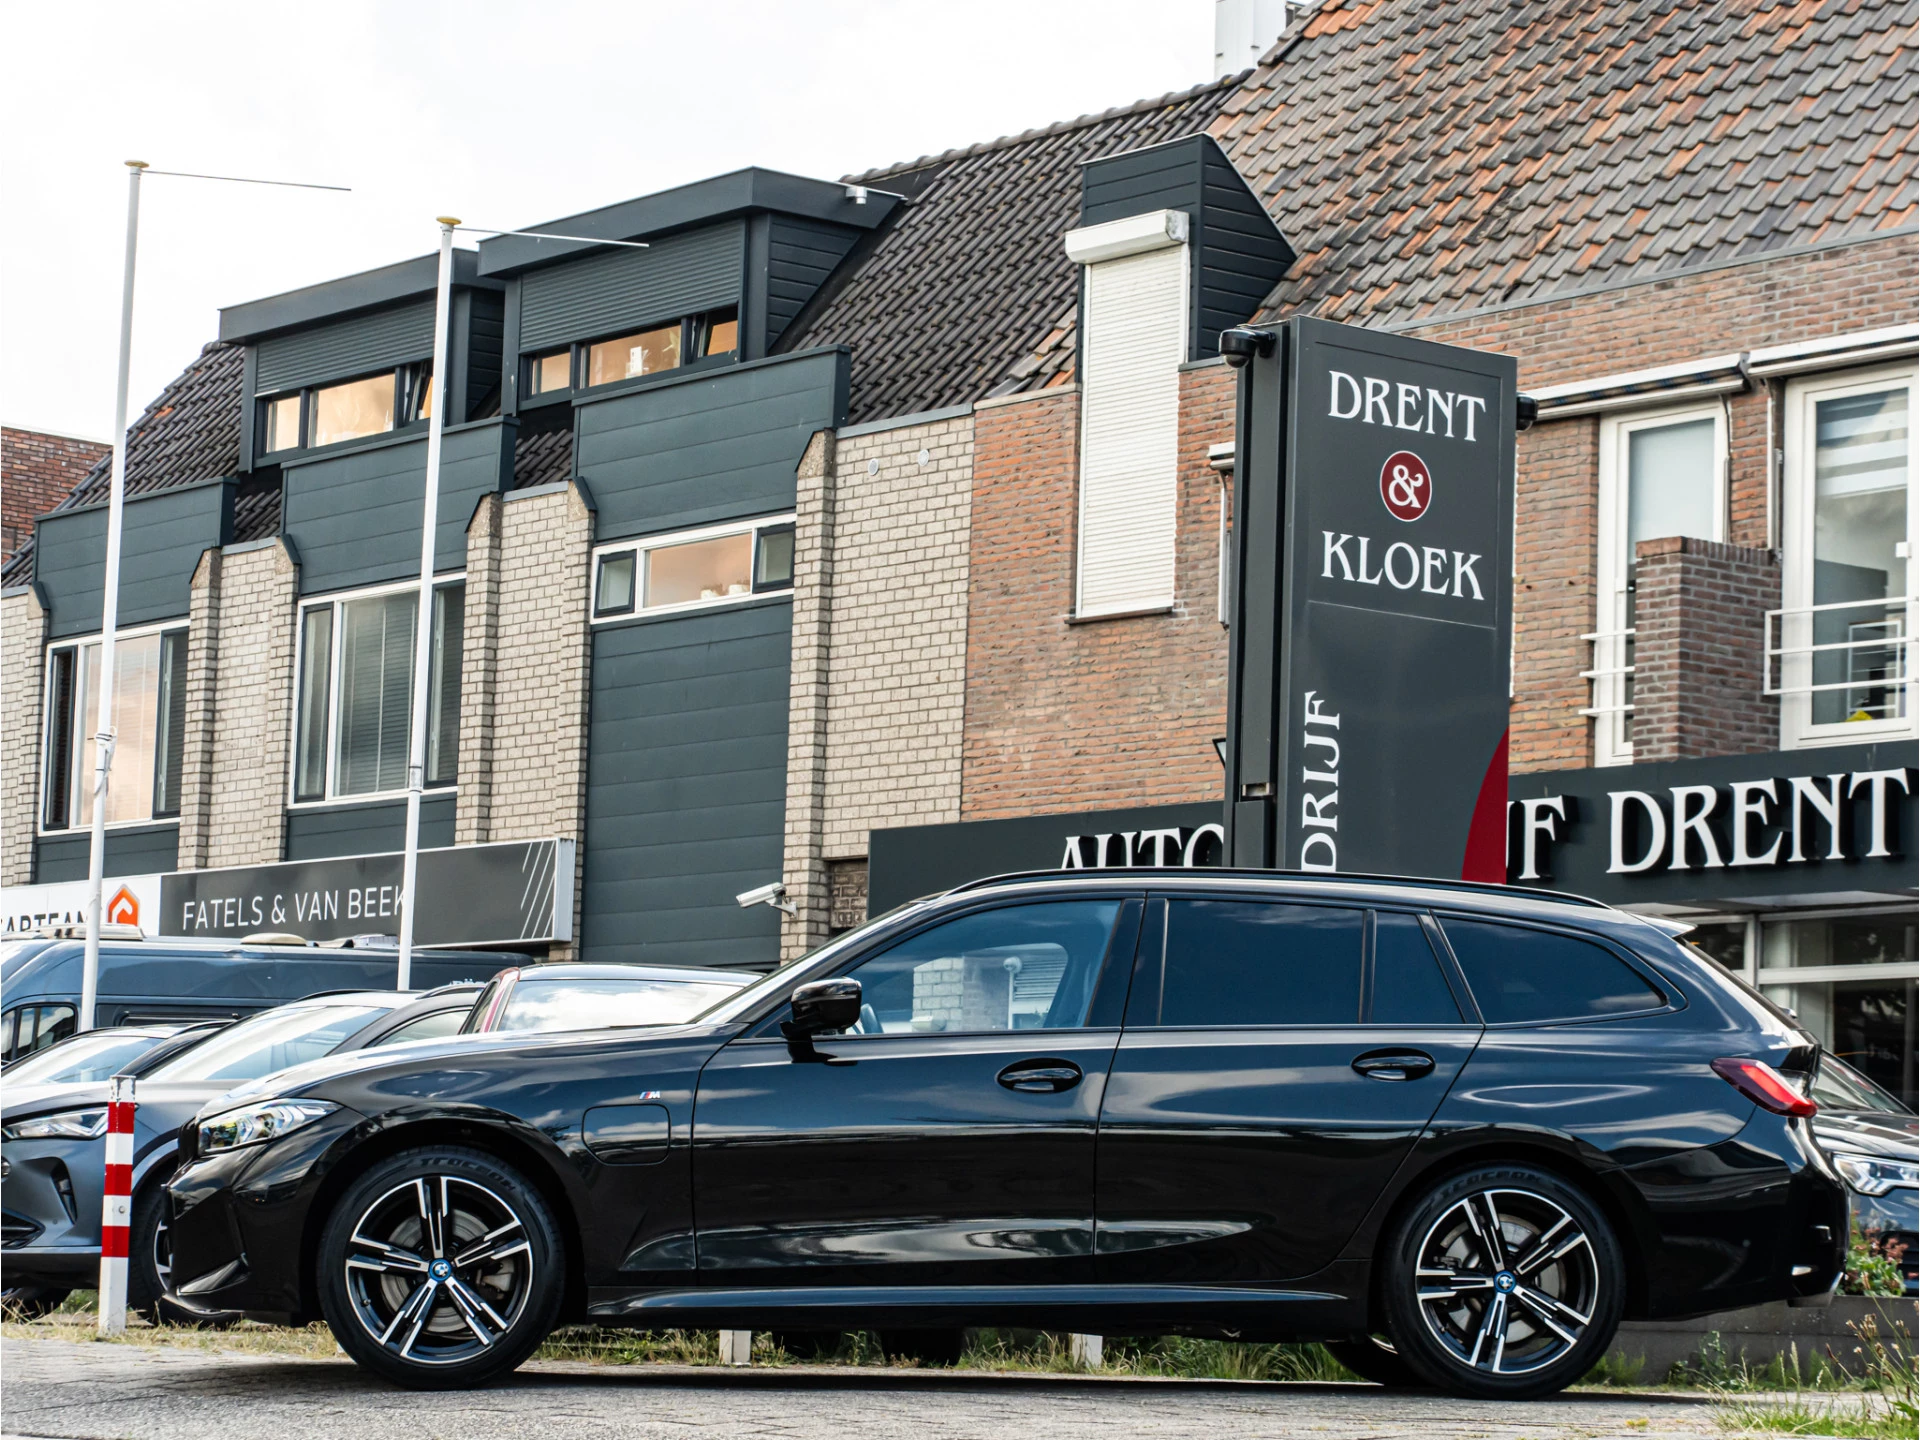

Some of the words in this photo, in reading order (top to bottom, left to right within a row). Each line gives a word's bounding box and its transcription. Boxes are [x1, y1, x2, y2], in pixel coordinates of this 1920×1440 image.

[1327, 370, 1487, 442] DRENT
[1388, 464, 1424, 509] &
[1321, 530, 1485, 601] KLOEK
[1300, 690, 1340, 872] DRIJF
[1606, 767, 1910, 873] DRENT
[182, 895, 263, 931] FATELS
[271, 894, 286, 924] &
[295, 890, 339, 922] VAN
[347, 885, 405, 919] BEEK
